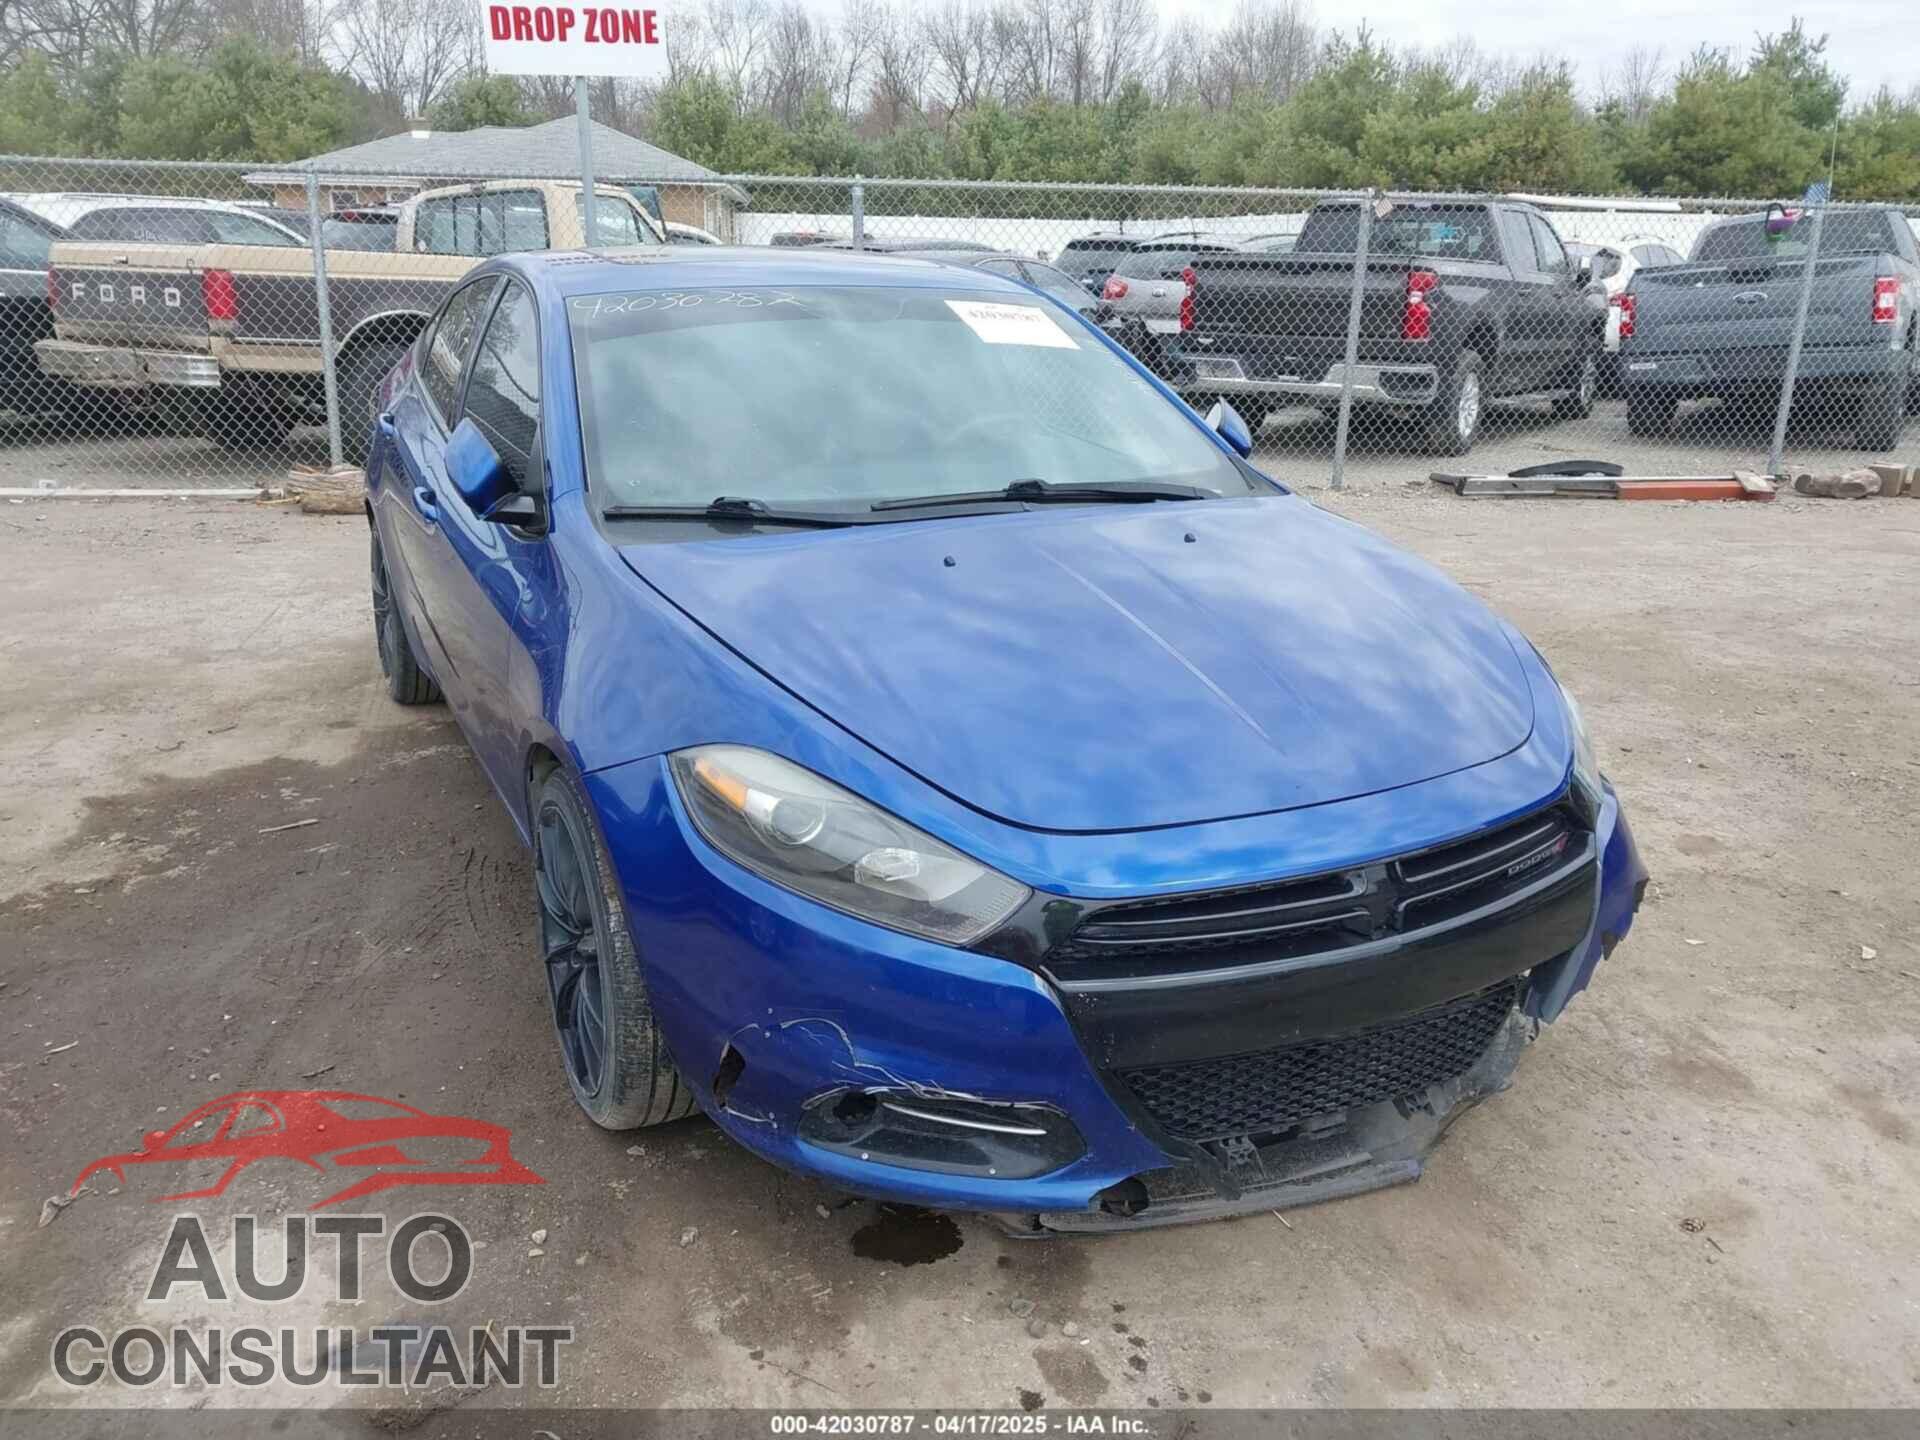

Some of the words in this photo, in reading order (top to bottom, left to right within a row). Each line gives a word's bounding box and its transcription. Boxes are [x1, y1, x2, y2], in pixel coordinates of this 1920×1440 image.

[489, 5, 575, 42] DROP
[583, 8, 659, 44] ZONE
[72, 283, 181, 307] FORD
